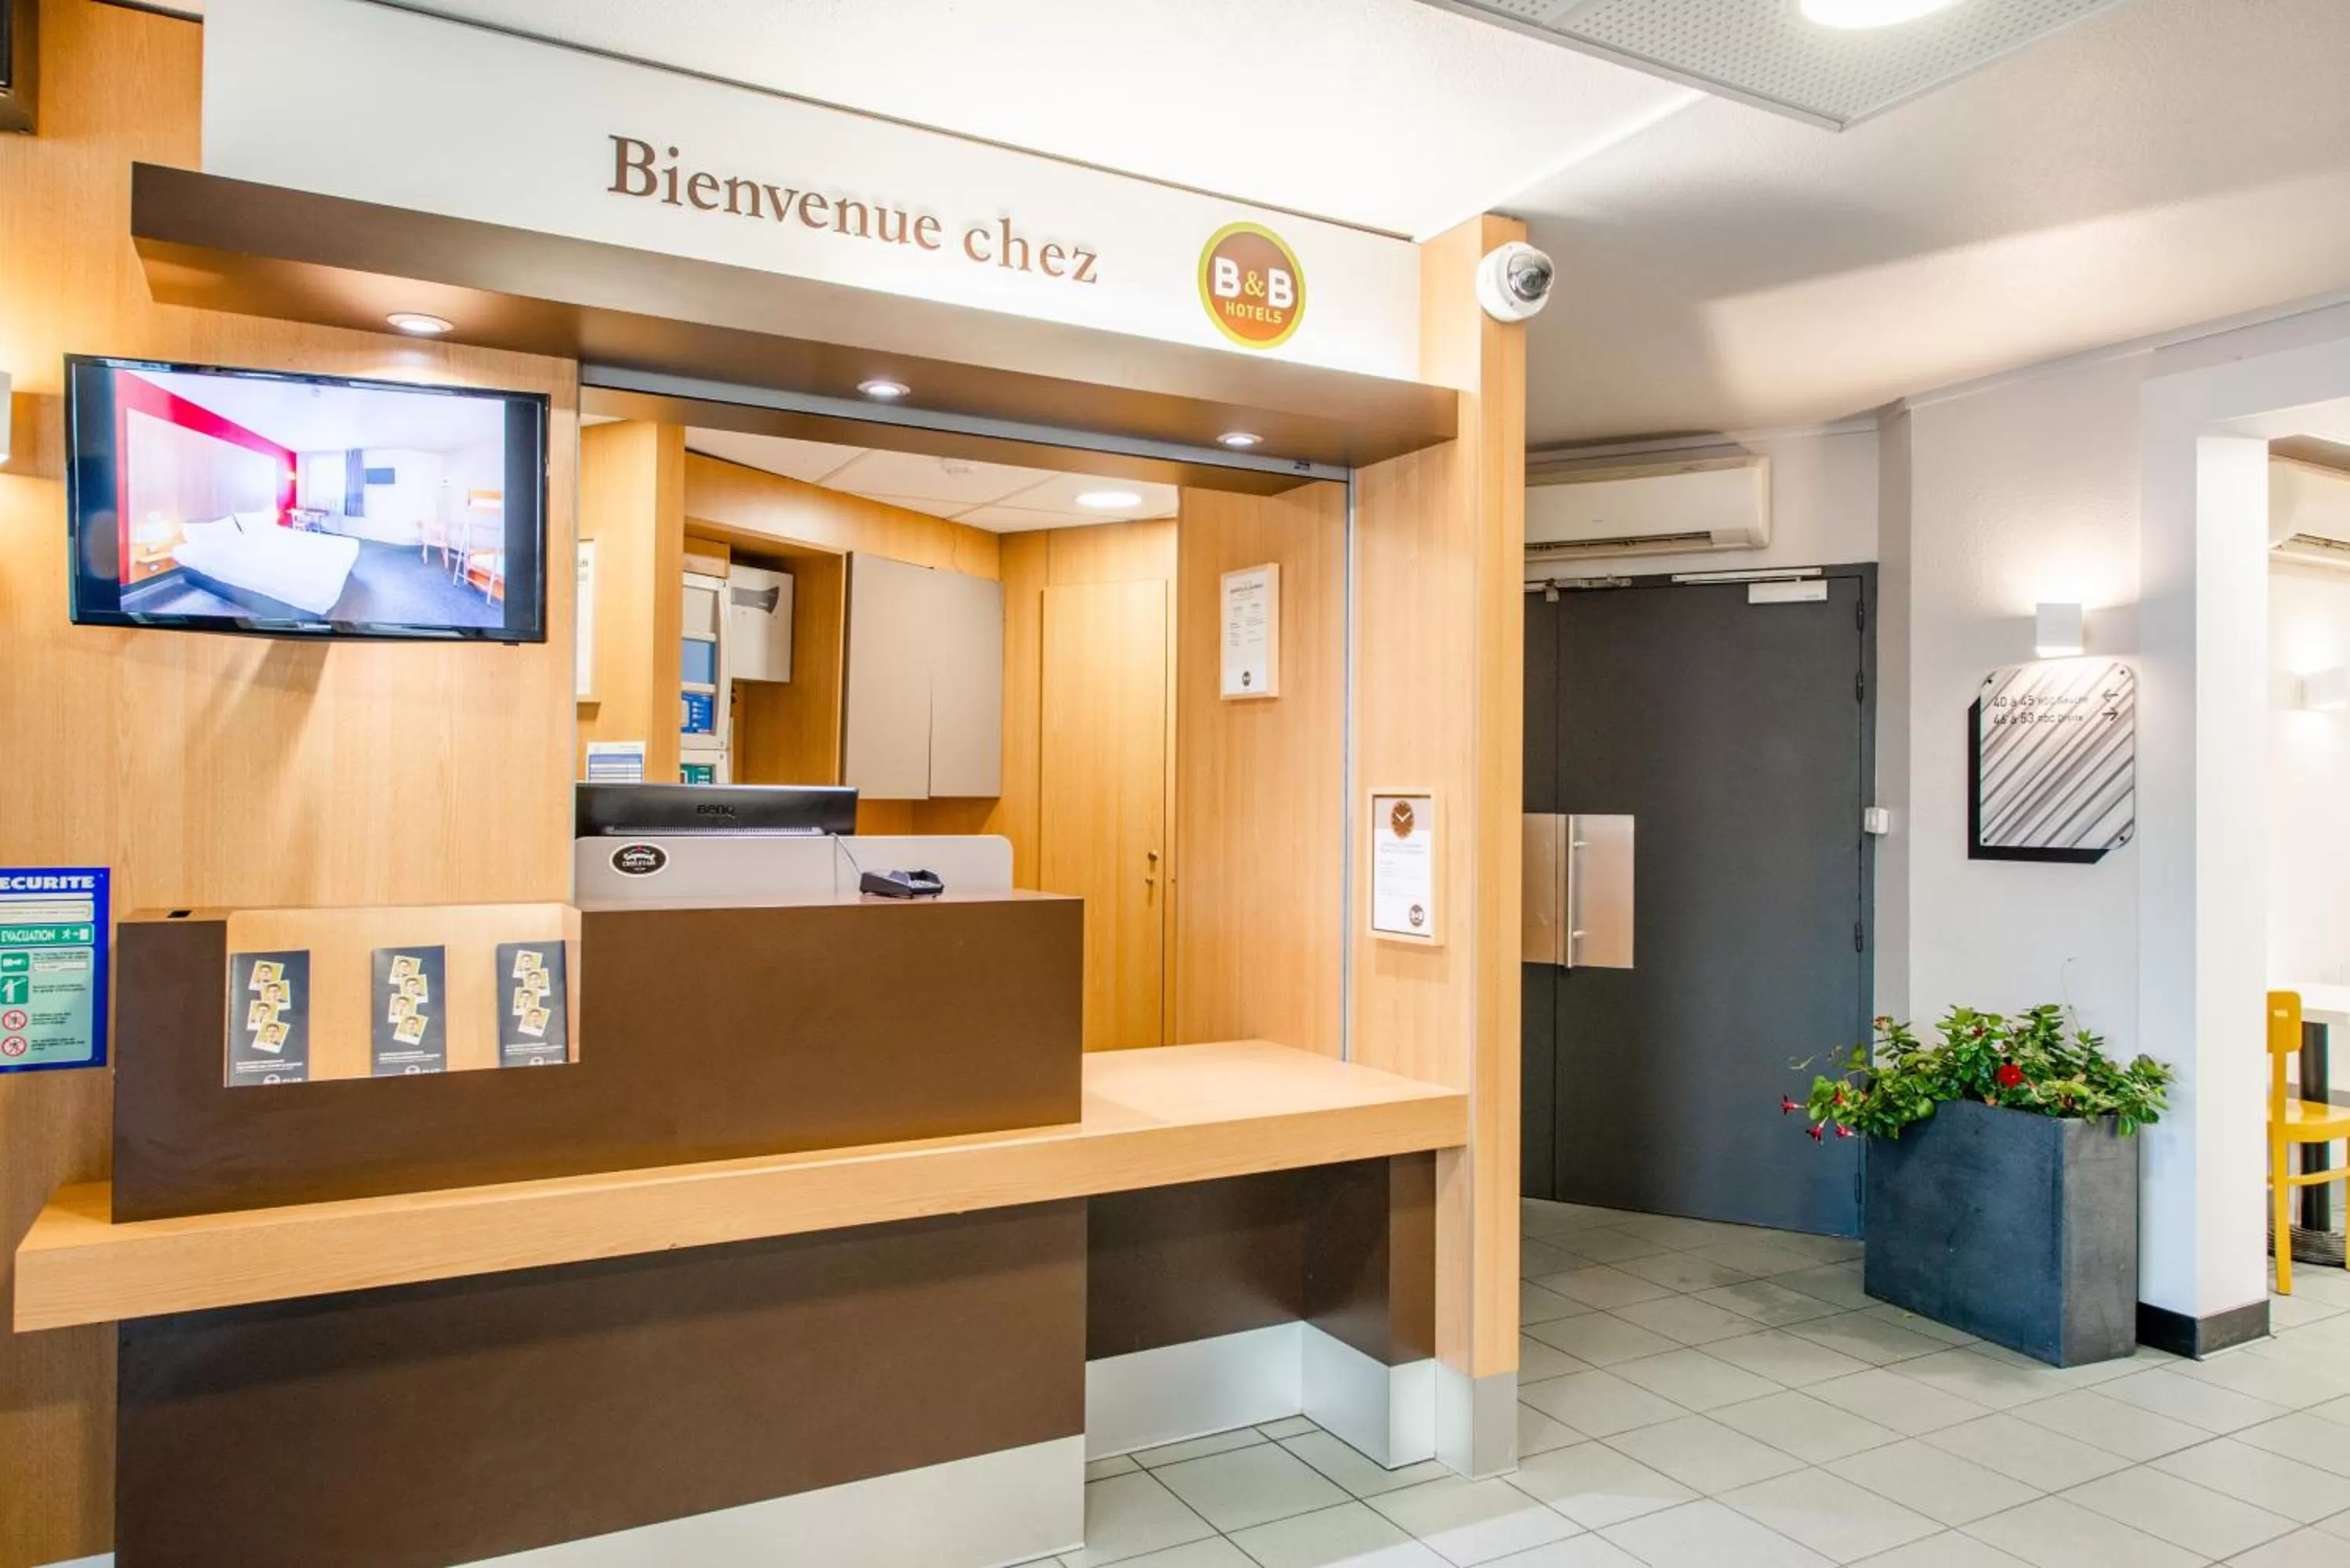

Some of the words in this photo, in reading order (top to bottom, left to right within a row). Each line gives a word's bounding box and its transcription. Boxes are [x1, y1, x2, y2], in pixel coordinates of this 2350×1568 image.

[607, 134, 942, 251] Bienvenue
[963, 219, 1098, 284] chez
[1225, 300, 1283, 324] HOTELS
[1993, 696, 2006, 707] 40
[2020, 695, 2034, 706] 45
[1993, 714, 2006, 724] 46
[2020, 712, 2034, 724] 53
[1, 928, 56, 942] EVACUATION
